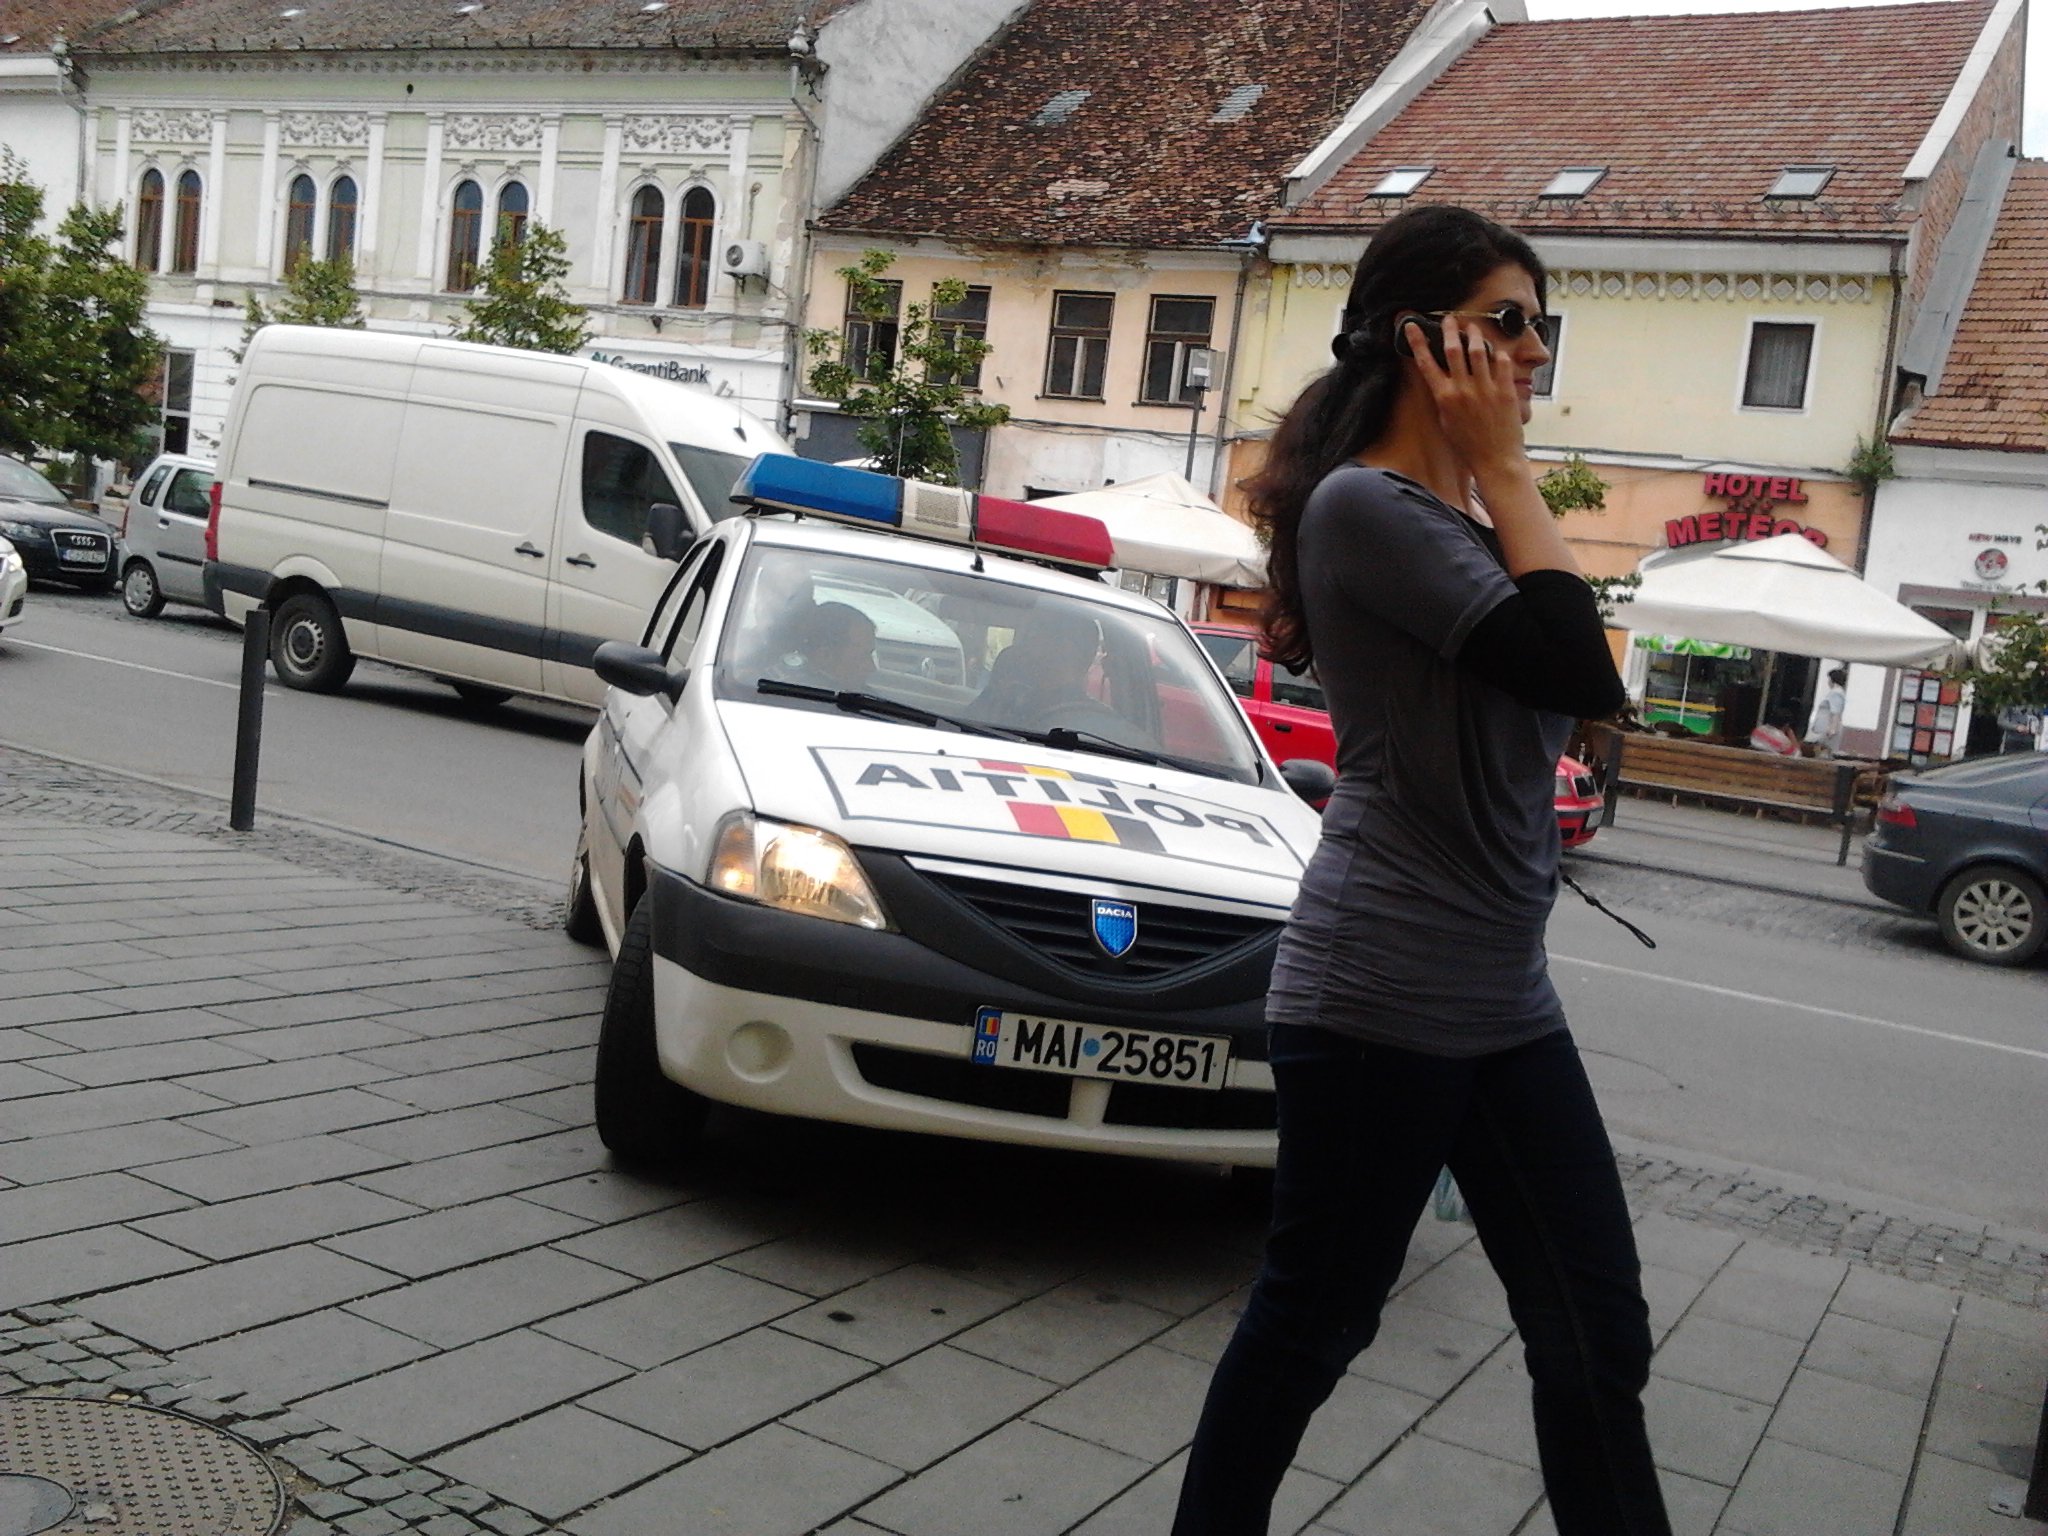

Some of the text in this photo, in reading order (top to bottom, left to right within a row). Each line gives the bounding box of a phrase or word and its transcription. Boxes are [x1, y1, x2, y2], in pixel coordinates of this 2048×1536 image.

[1704, 473, 1808, 504] HOTEL
[1097, 906, 1133, 919] DACIA
[976, 1039, 996, 1058] RO
[1013, 1019, 1215, 1083] MAI 25851
